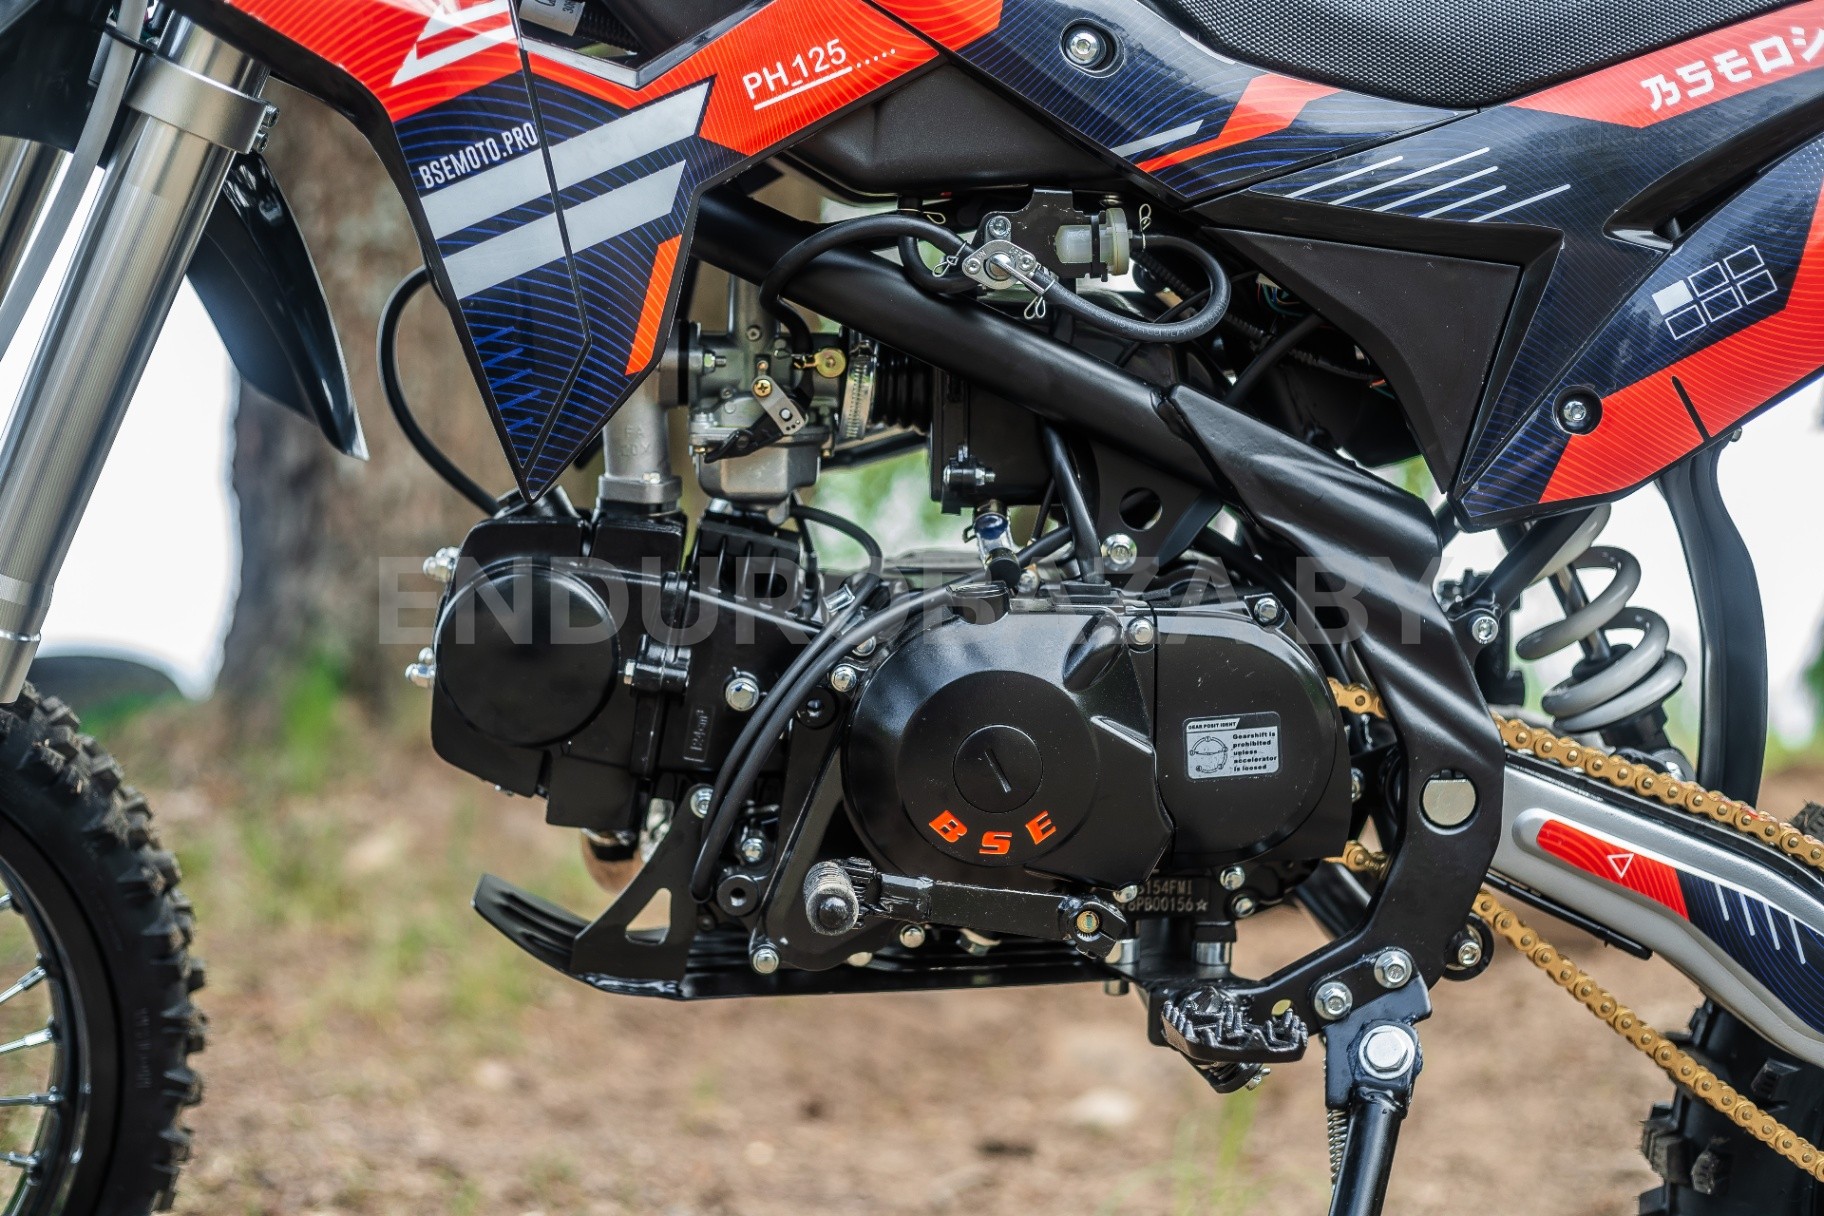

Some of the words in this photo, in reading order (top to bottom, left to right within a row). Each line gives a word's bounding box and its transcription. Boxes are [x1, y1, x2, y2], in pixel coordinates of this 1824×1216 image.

[418, 121, 539, 189] BSEMOTO.PRO
[1232, 731, 1268, 740] Gearshift
[1233, 740, 1271, 748] prohibited
[1233, 755, 1277, 764] accelerator
[928, 809, 1057, 855] BSE
